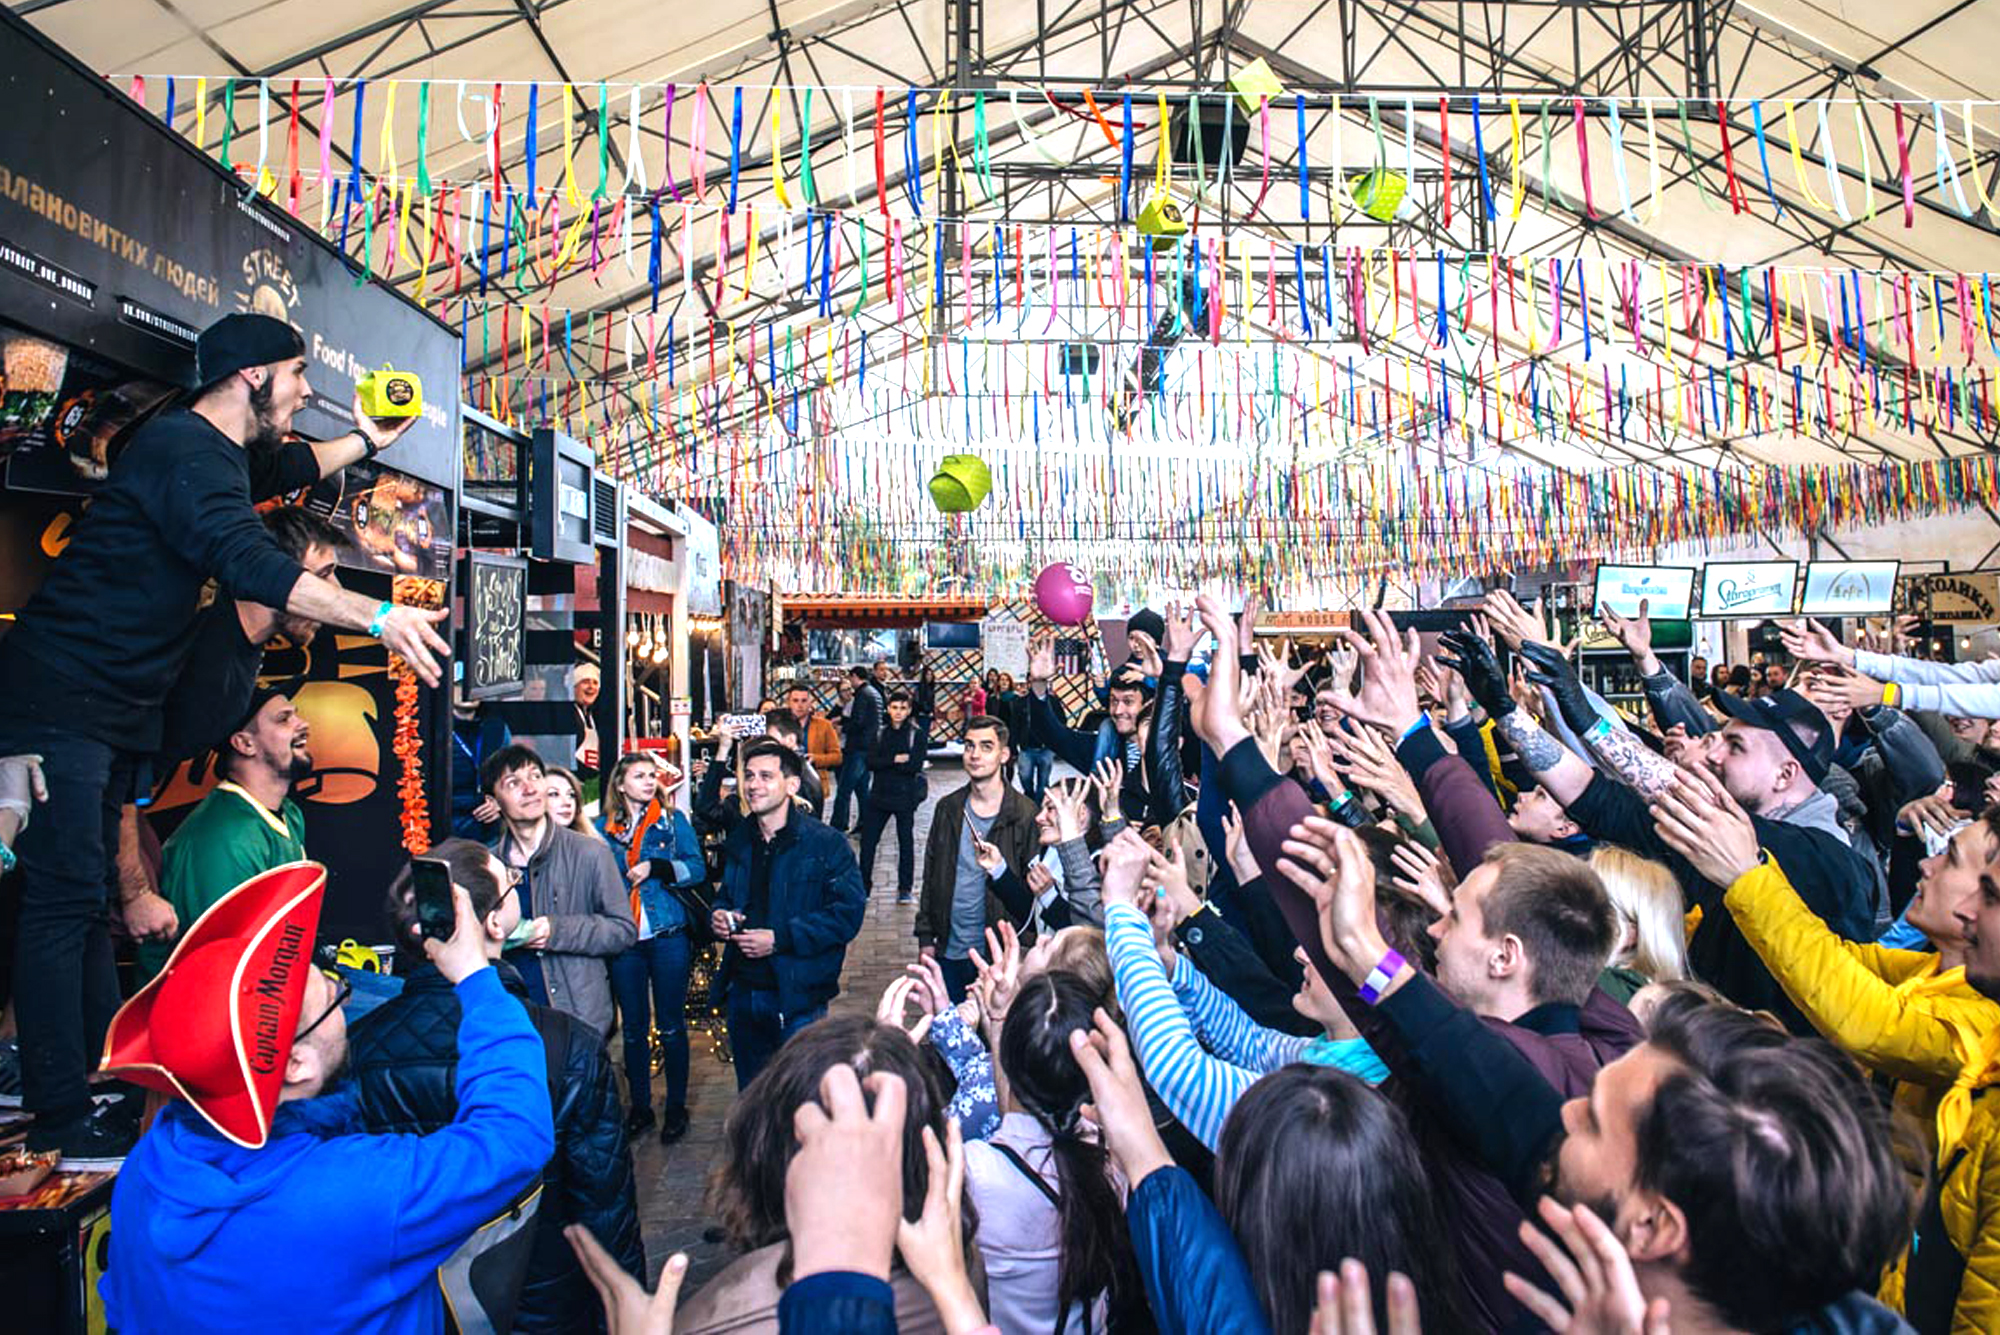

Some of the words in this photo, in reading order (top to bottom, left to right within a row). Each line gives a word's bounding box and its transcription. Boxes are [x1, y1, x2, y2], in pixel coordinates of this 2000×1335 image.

[153, 253, 220, 308] людей
[242, 248, 301, 308] STREET
[313, 333, 346, 373] Food
[255, 920, 307, 1005] Morgan
[249, 1003, 279, 1075] Captain
